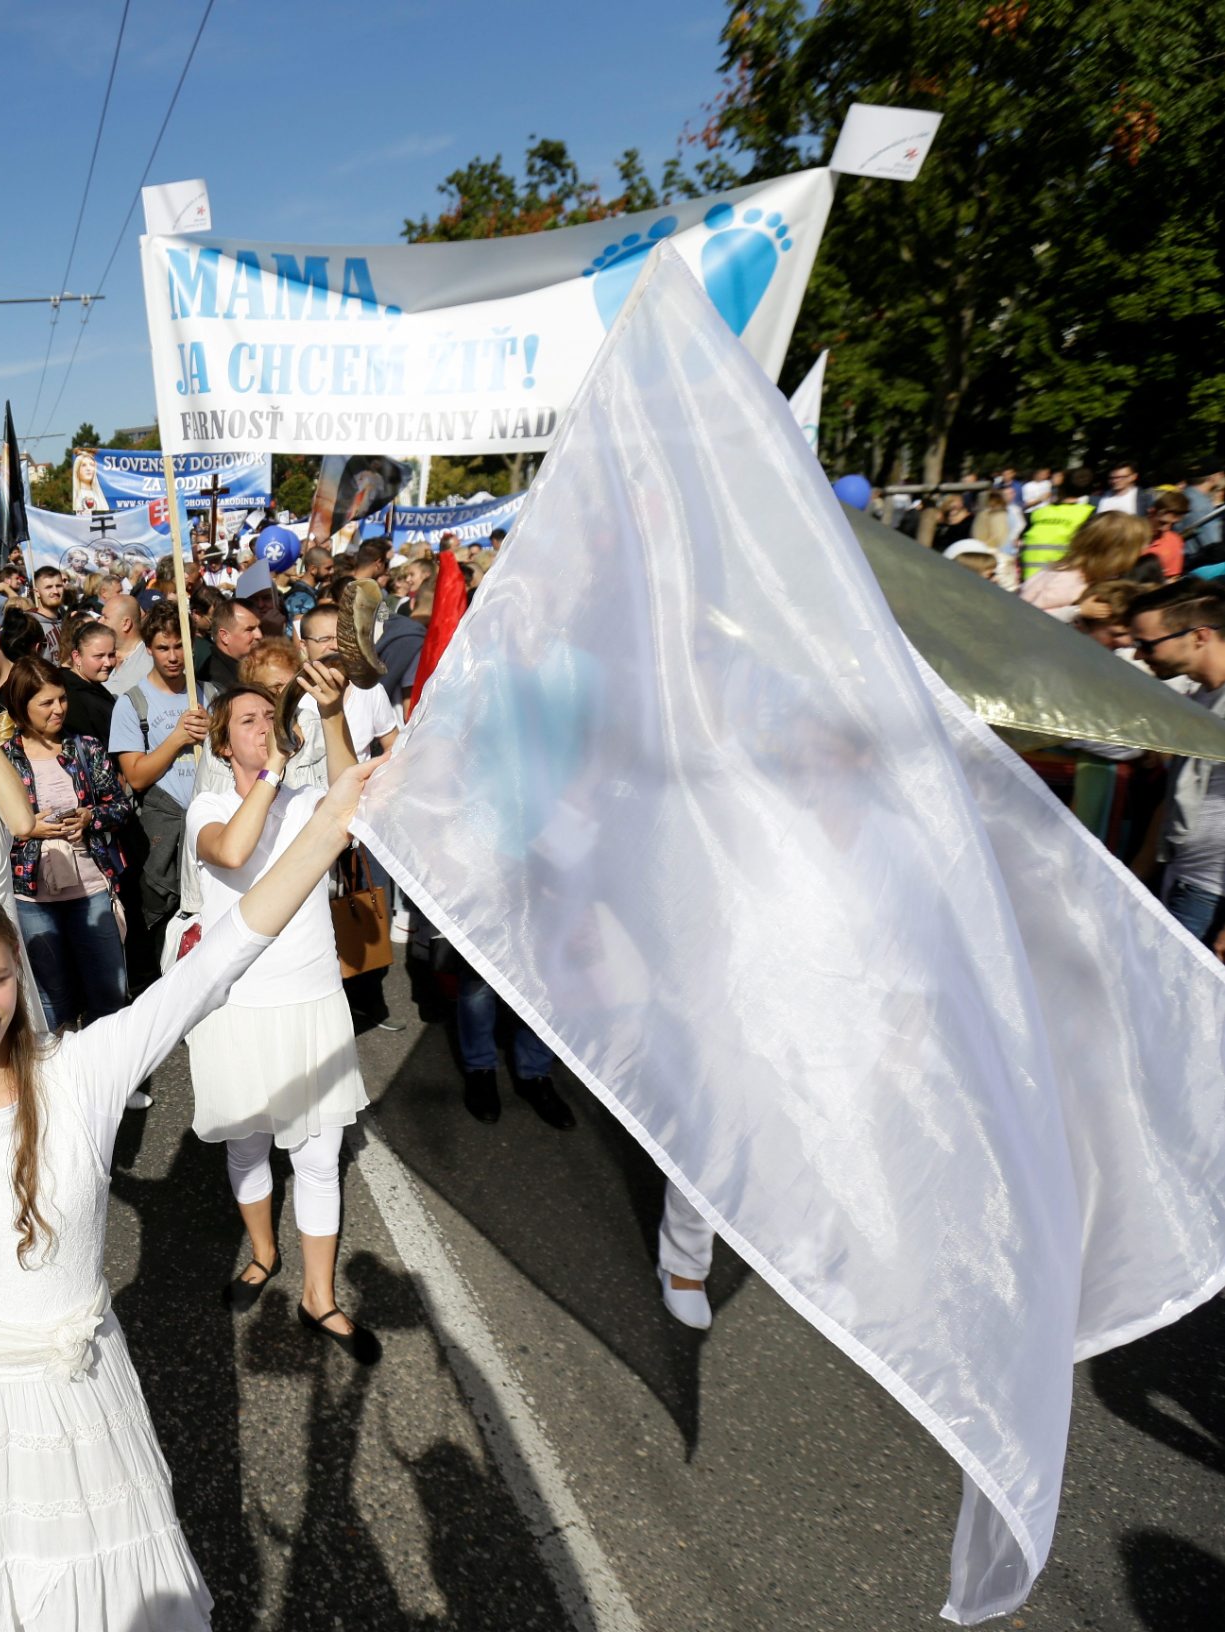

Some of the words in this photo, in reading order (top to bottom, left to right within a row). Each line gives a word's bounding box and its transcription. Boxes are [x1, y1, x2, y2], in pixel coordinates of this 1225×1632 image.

[167, 248, 402, 330] MAMA,
[176, 341, 211, 396] JA
[228, 341, 407, 396] CHCEM
[427, 325, 540, 395] ŽIŤ!
[180, 405, 284, 441] FARNOSŤ
[293, 408, 479, 442] KOSTOĽANY
[489, 405, 557, 439] NAD
[190, 452, 265, 471] DOHOVOR
[142, 478, 161, 491] ZA
[164, 475, 222, 491] ODIN
